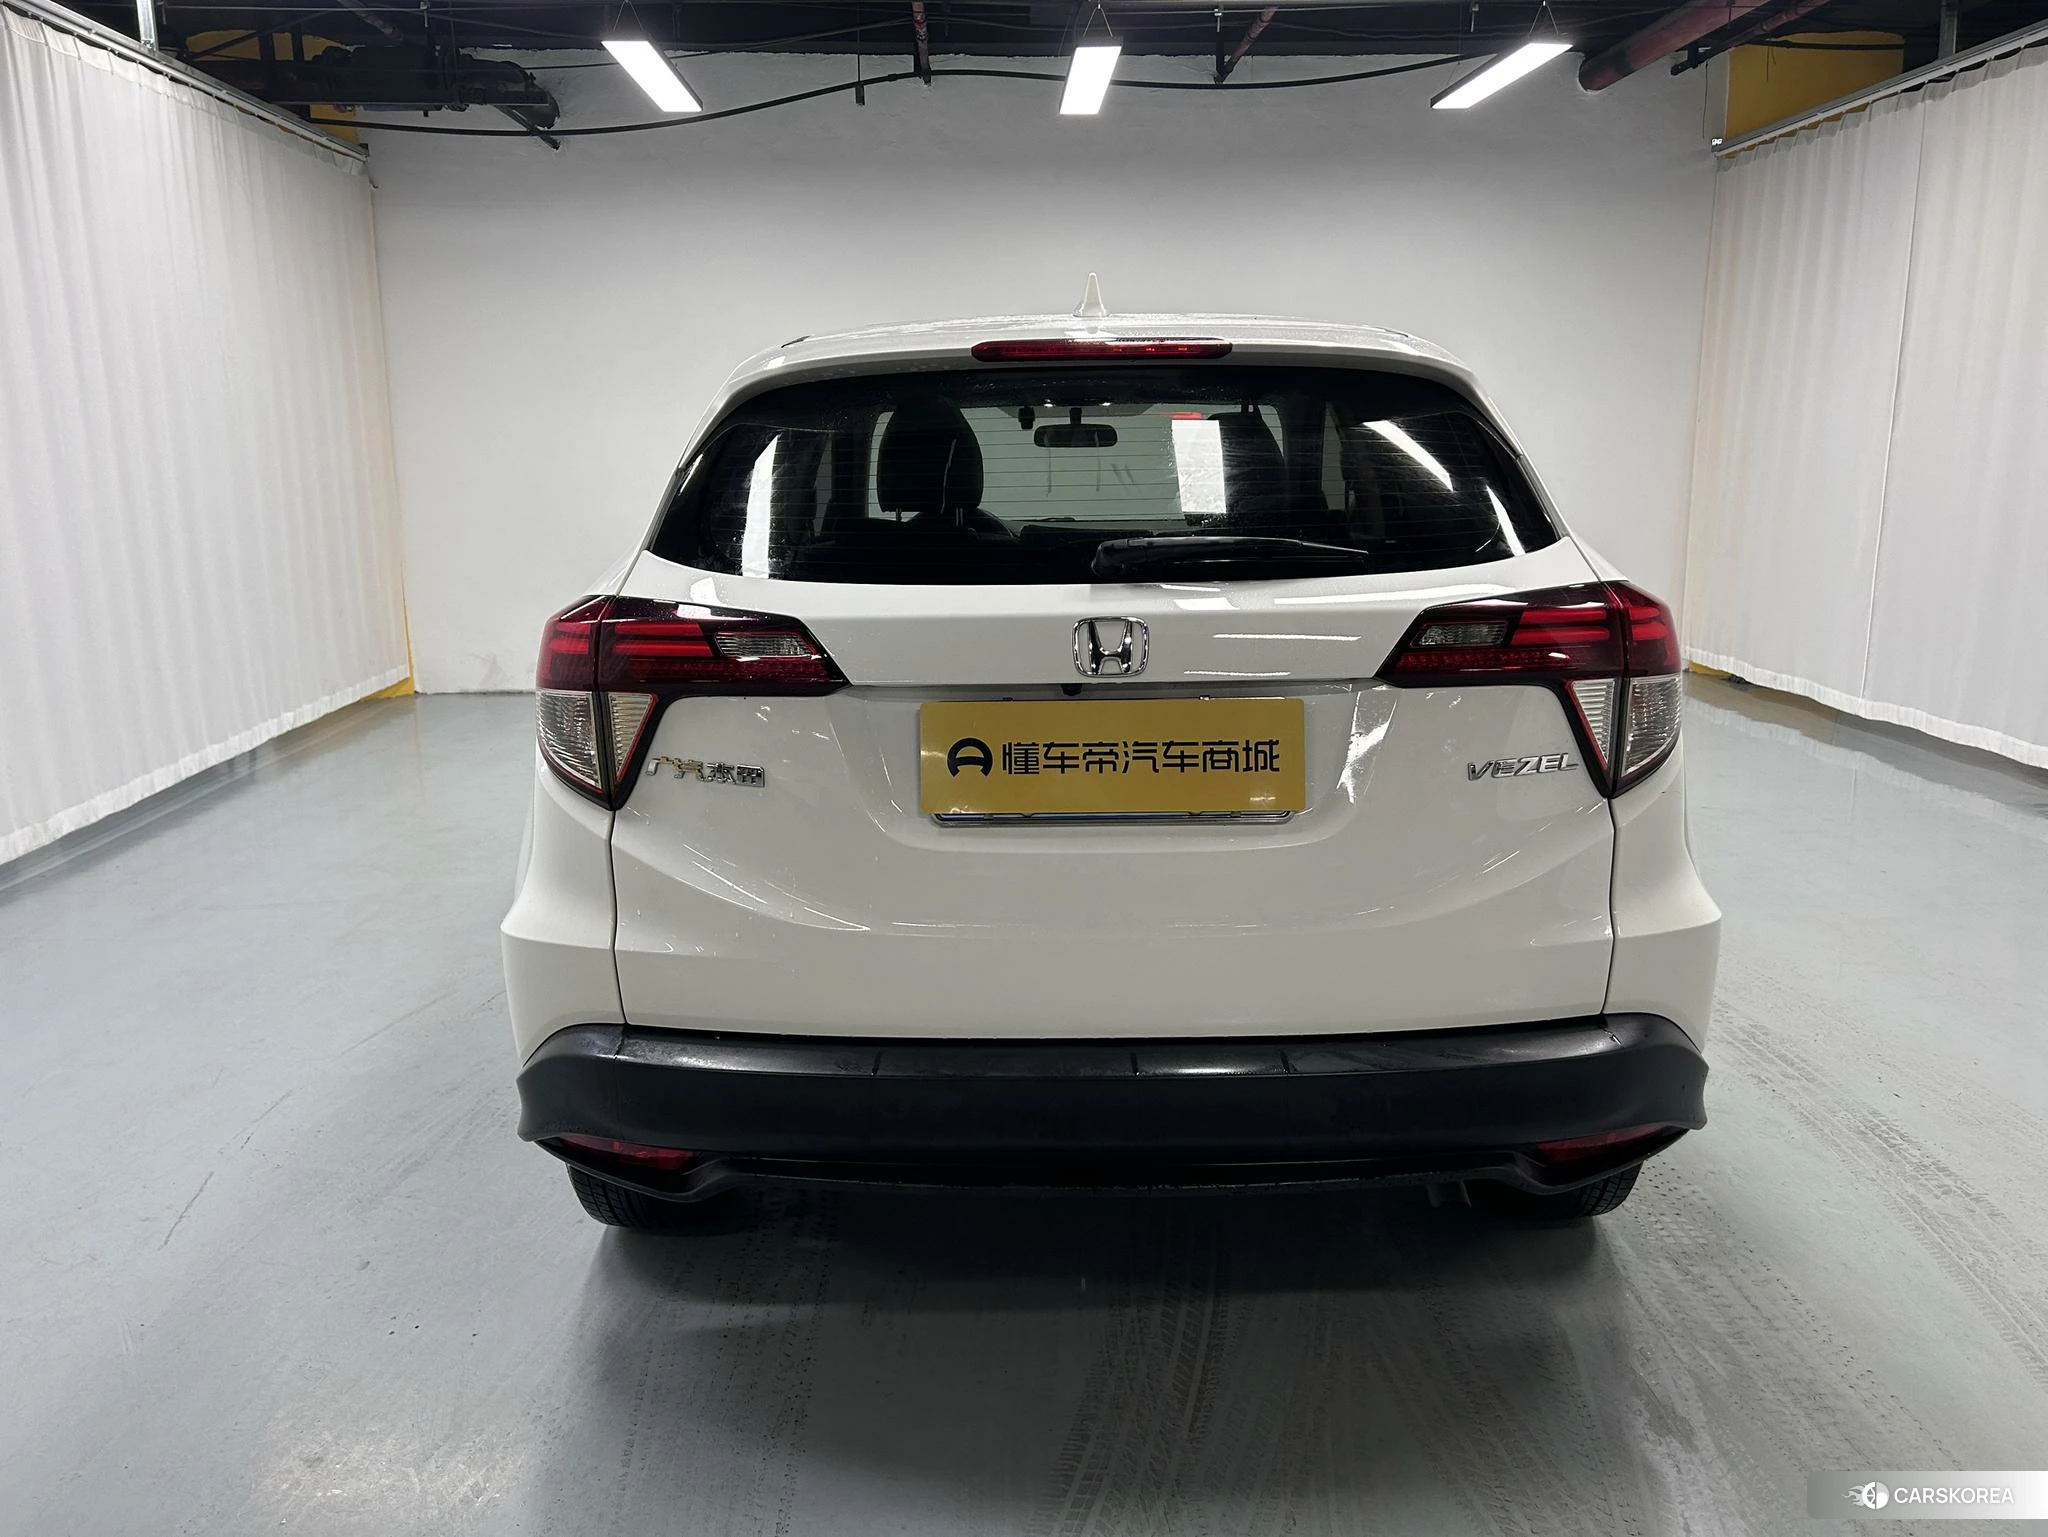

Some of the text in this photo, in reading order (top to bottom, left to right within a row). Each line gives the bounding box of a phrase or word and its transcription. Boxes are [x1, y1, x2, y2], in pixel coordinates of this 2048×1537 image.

[1002, 739, 1280, 776] 懂车帝汽车商城
[1467, 752, 1579, 781] VEZEL
